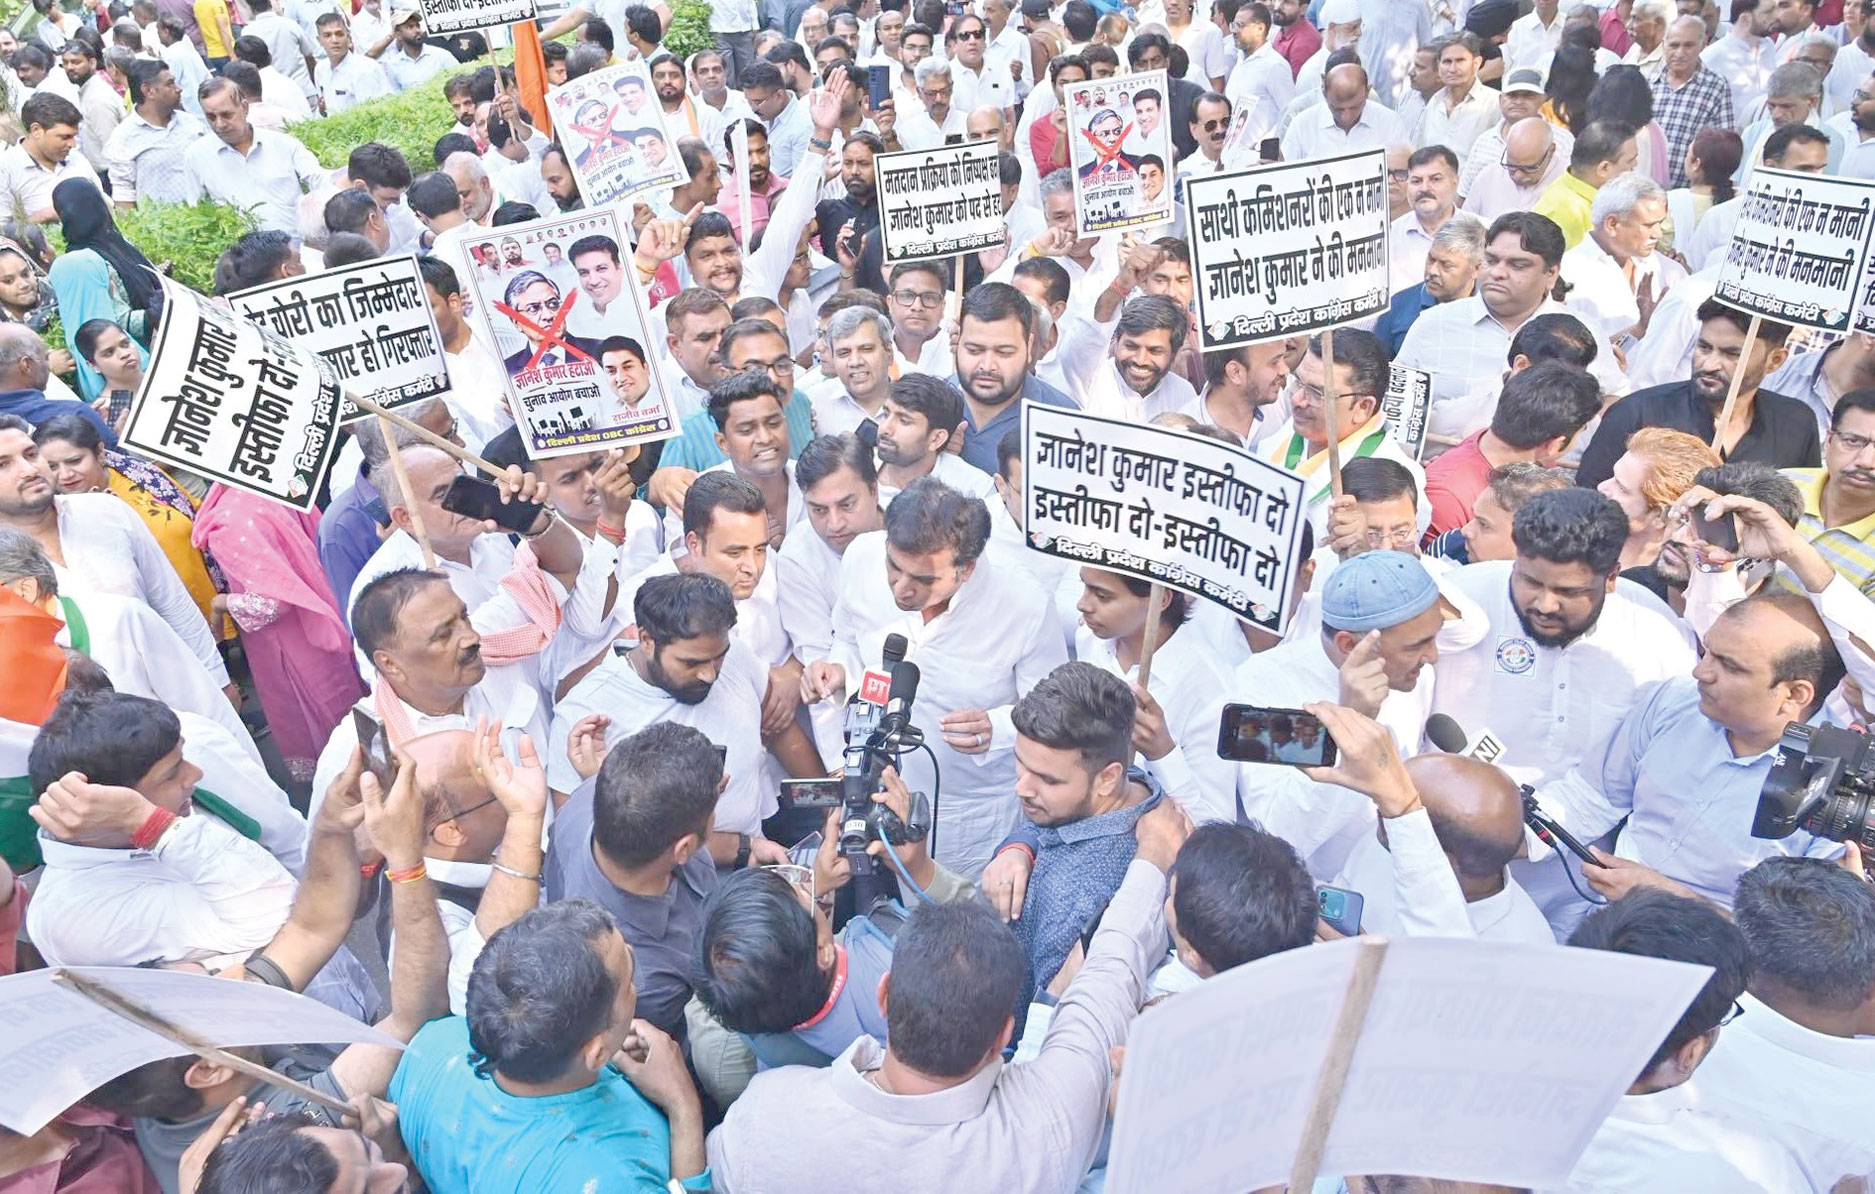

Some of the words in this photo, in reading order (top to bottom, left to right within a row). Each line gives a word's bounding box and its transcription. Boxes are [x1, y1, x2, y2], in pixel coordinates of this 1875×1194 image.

[883, 167, 919, 195] मतदान
[919, 156, 950, 192] प्रक्रिया
[949, 153, 962, 186] को
[962, 152, 990, 186] निष्पक्ष
[888, 200, 923, 232] ज्ञानेश
[924, 201, 953, 235] कुमार
[954, 192, 967, 222] को
[968, 197, 982, 220] पद
[982, 188, 992, 218] से
[1198, 189, 1240, 243] साथी
[1240, 177, 1316, 236] कमिशनरों
[1316, 174, 1334, 224] की
[1334, 181, 1353, 221] एक
[1354, 180, 1364, 216] न
[1365, 164, 1384, 214] मानी
[1784, 188, 1802, 231] की
[1798, 200, 1818, 233] एक
[1816, 203, 1832, 235] न
[1829, 197, 1870, 241] मानी
[906, 240, 934, 255] दिल्ली
[936, 238, 958, 253] प्रदेश
[959, 233, 986, 248] कांग्रेस
[1205, 248, 1260, 300] ज्ञानेश
[1262, 249, 1309, 305] कुमार
[1309, 235, 1324, 282] ने
[1324, 231, 1344, 279] की
[1345, 220, 1386, 275] मनमानी
[1765, 236, 1778, 276] ने
[1776, 238, 1794, 280] की
[1789, 248, 1854, 291] मनमानी
[266, 290, 314, 338] चोरी
[311, 292, 346, 328] का
[343, 271, 422, 322] जिम्मेदार
[1233, 310, 1276, 336] दिल्ली
[1278, 307, 1311, 332] प्रदेश
[1313, 298, 1352, 324] कांग्रेस
[1353, 288, 1378, 313] कमेटी
[1754, 293, 1784, 314] कांग्रेस
[1784, 301, 1820, 321] कमेटी
[187, 316, 245, 390] कुमार
[356, 329, 381, 373] हो
[376, 325, 437, 369] गिरफ्तार
[402, 374, 436, 397] कमेटी
[514, 367, 542, 390] ज्ञानेश
[543, 364, 568, 386] कुमार
[568, 358, 596, 378] हटाओ
[523, 393, 548, 412] चुनाव
[548, 388, 574, 403] आयोग
[574, 384, 600, 400] बचाओ
[1412, 382, 1427, 406] कमेटी
[160, 374, 224, 457] ज्ञानेश
[228, 385, 294, 484] इस्तीफा
[294, 424, 326, 472] दिल्ली
[311, 386, 334, 426] प्रदेश
[546, 435, 576, 448] दिल्ली
[578, 432, 600, 443] प्रदेश
[602, 430, 624, 440] OBC
[625, 424, 657, 436] कांग्रेस
[612, 408, 640, 422] राजीव
[641, 404, 661, 416] वर्मा
[1408, 408, 1424, 441] कांग्रेस
[1036, 428, 1106, 477] ज्ञानेश
[1111, 446, 1178, 493] कुमार
[1182, 462, 1262, 522] इस्तीफा
[1265, 487, 1289, 536] दो
[1034, 485, 1122, 533] इस्तीफा
[1255, 545, 1280, 591] दो
[1057, 536, 1102, 561] दिल्ली
[1105, 548, 1145, 570] प्रदेश
[1148, 562, 1202, 588] कांग्रेस
[1204, 580, 1250, 612] कमेटी
